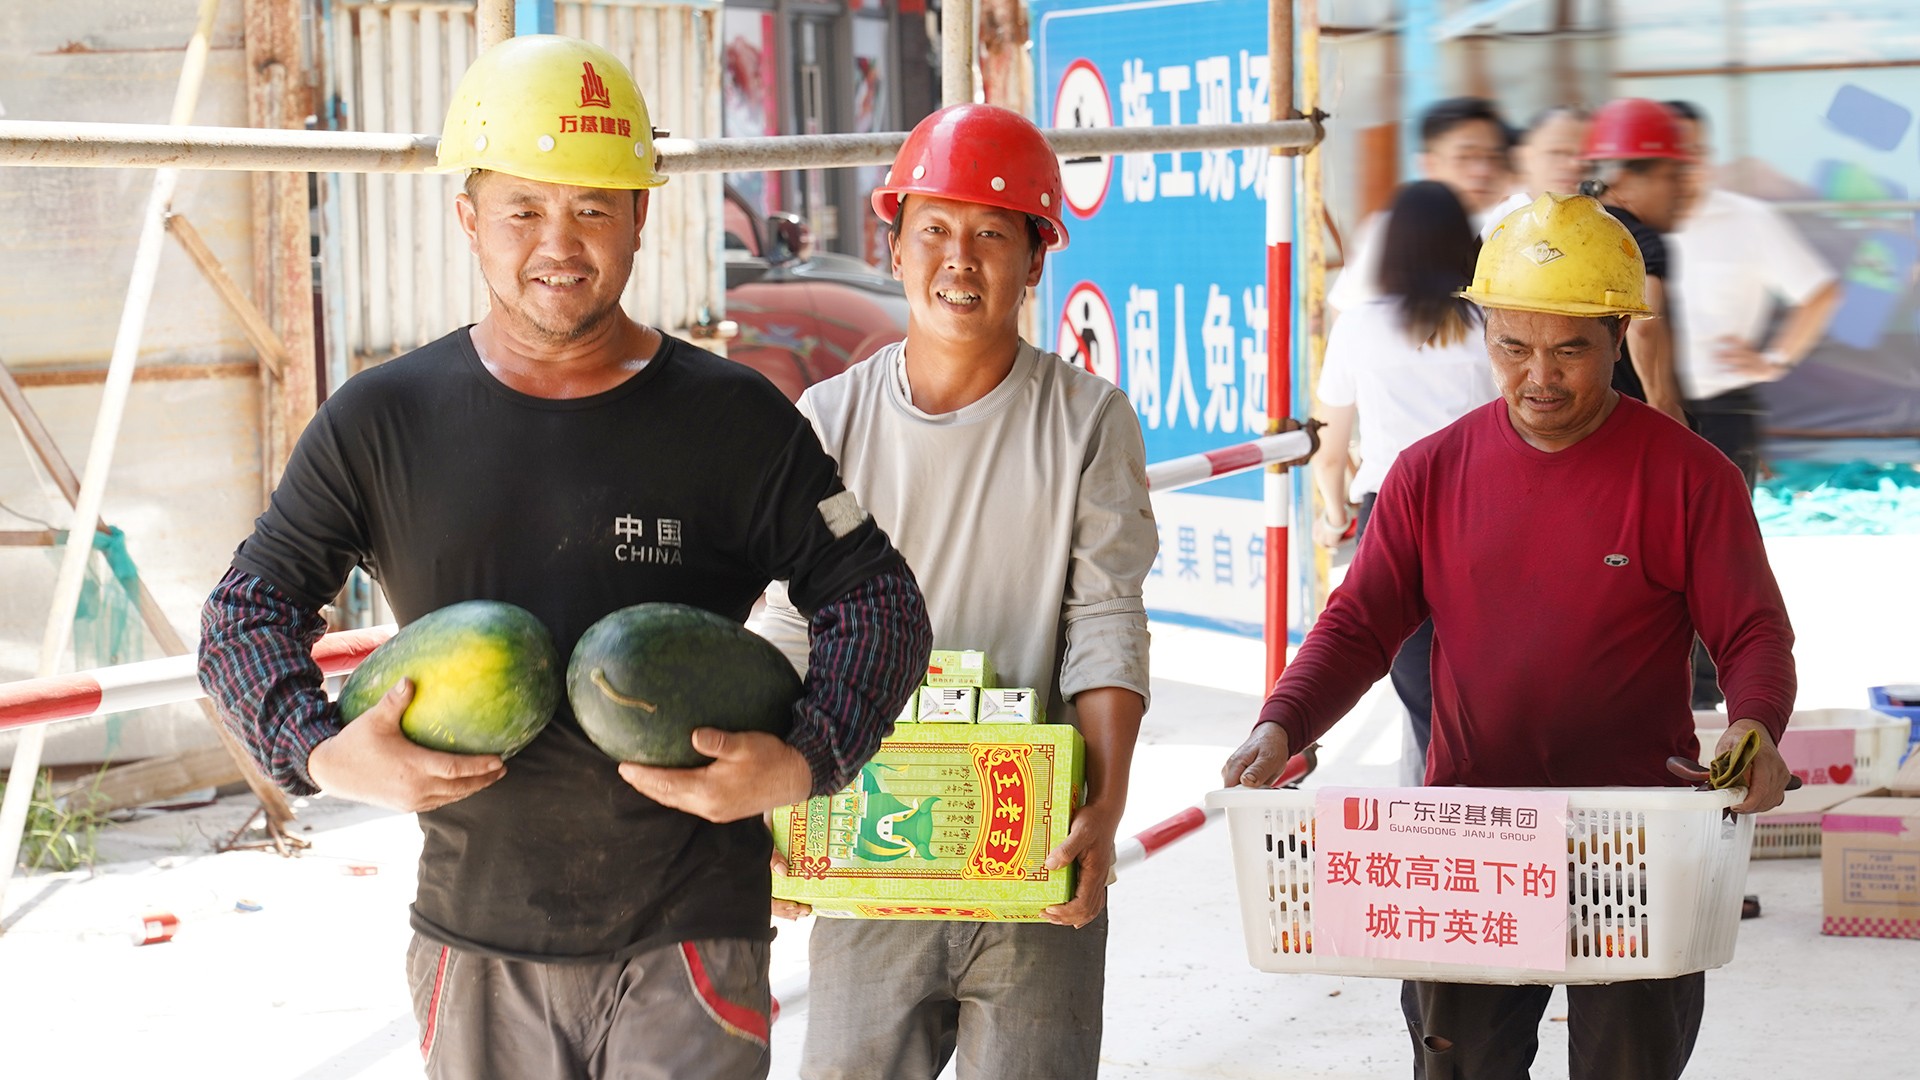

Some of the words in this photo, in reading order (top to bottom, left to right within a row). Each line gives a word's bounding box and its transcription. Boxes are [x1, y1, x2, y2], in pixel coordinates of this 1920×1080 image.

[559, 115, 631, 137] 万基建设
[1120, 50, 1268, 202] 施工现场
[615, 513, 682, 547] 中国
[615, 543, 682, 565] CHINA
[1151, 525, 1265, 588] 果自负
[807, 794, 825, 856] 料就是牛
[990, 771, 1023, 852] 王老吉
[1389, 800, 1538, 829] 广东坚基集团
[1389, 823, 1457, 837] GUANGDONG
[1462, 830, 1495, 839] JIANJI
[1500, 832, 1536, 842] GROUP
[1327, 850, 1556, 898] 致敬高温下的
[1365, 903, 1519, 947] 城市英雄
